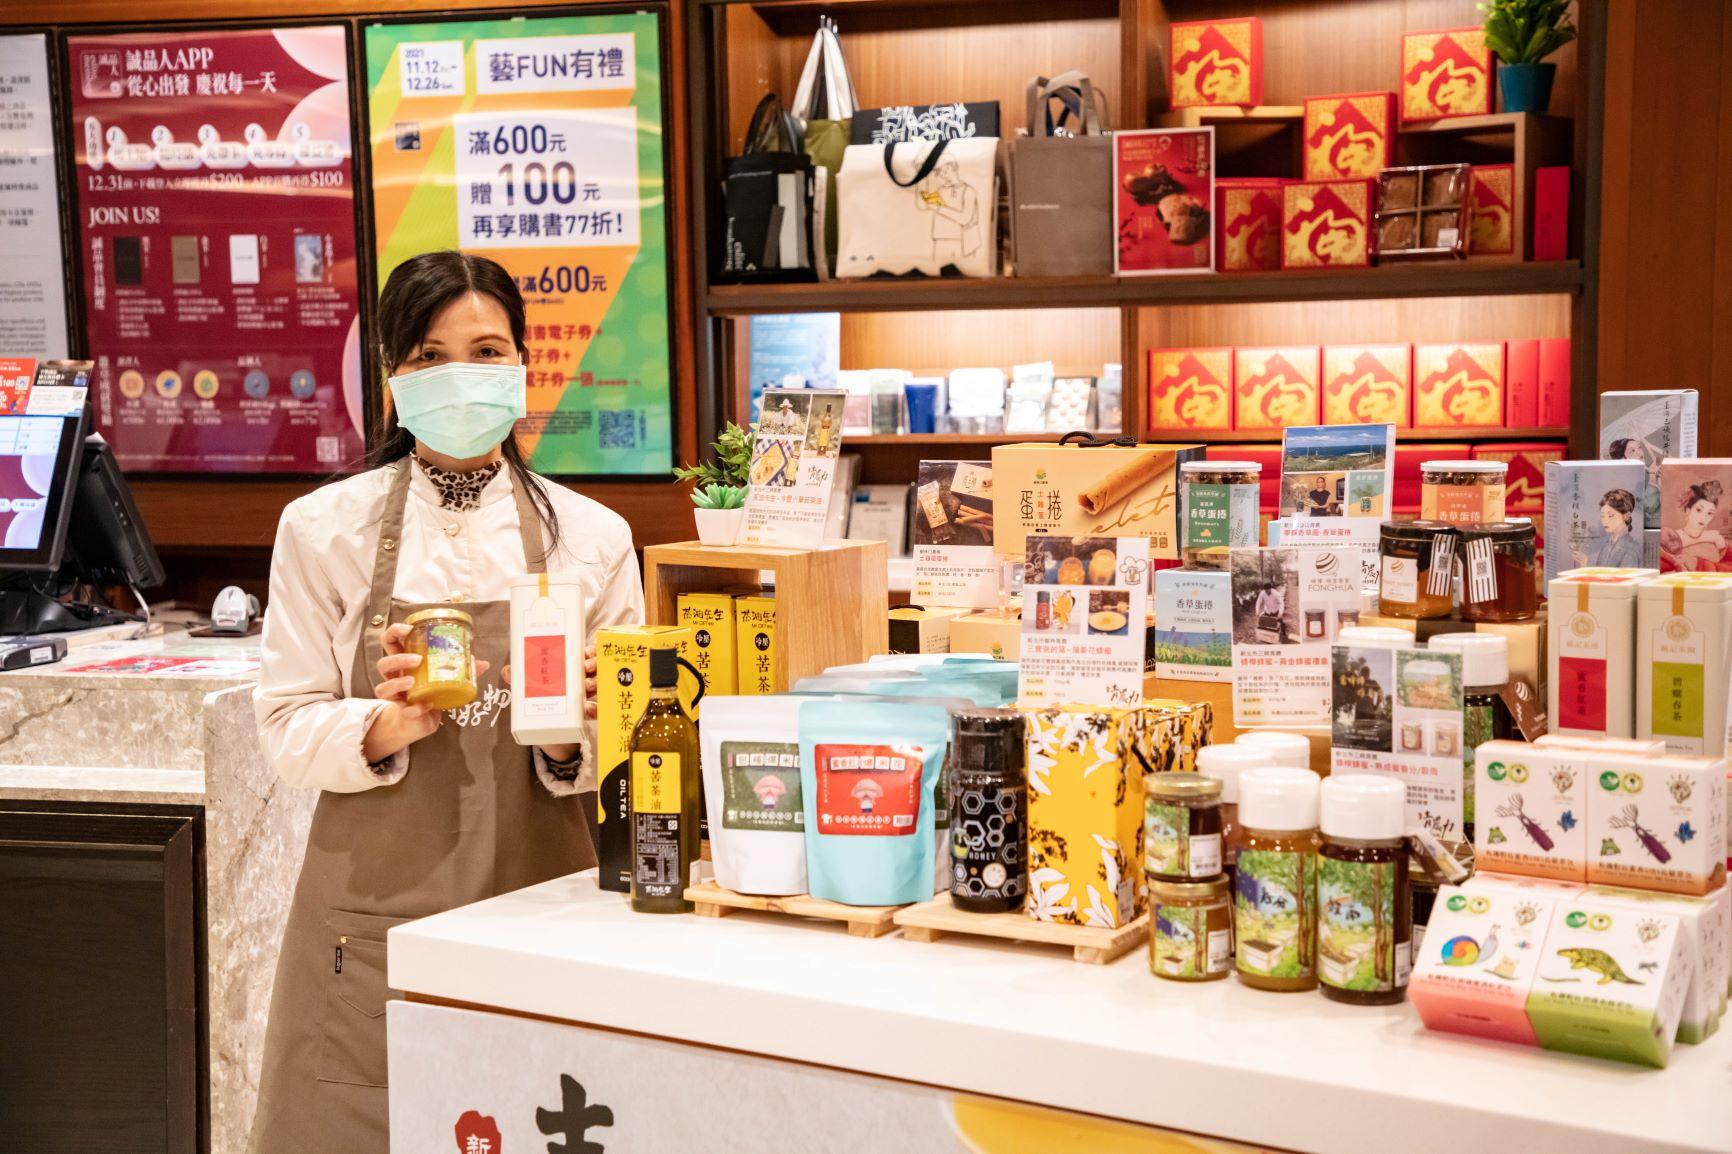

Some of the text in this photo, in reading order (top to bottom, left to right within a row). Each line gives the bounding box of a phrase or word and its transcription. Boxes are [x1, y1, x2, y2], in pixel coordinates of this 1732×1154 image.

[126, 48, 214, 71] 誠品人APP
[407, 61, 440, 74] 11.12
[489, 48, 625, 82] 藝FUN有禮
[407, 77, 440, 91] 12.26
[469, 125, 567, 156] 滿600元
[310, 171, 343, 187] $100
[89, 206, 160, 228] JOIN US!
[1191, 508, 1227, 519] 香草蛋捲
[1176, 598, 1213, 609] 香草蛋捲
[619, 779, 627, 819] OIL TEA
[651, 771, 661, 810] 苦茶油
[969, 852, 996, 861] HONEY
